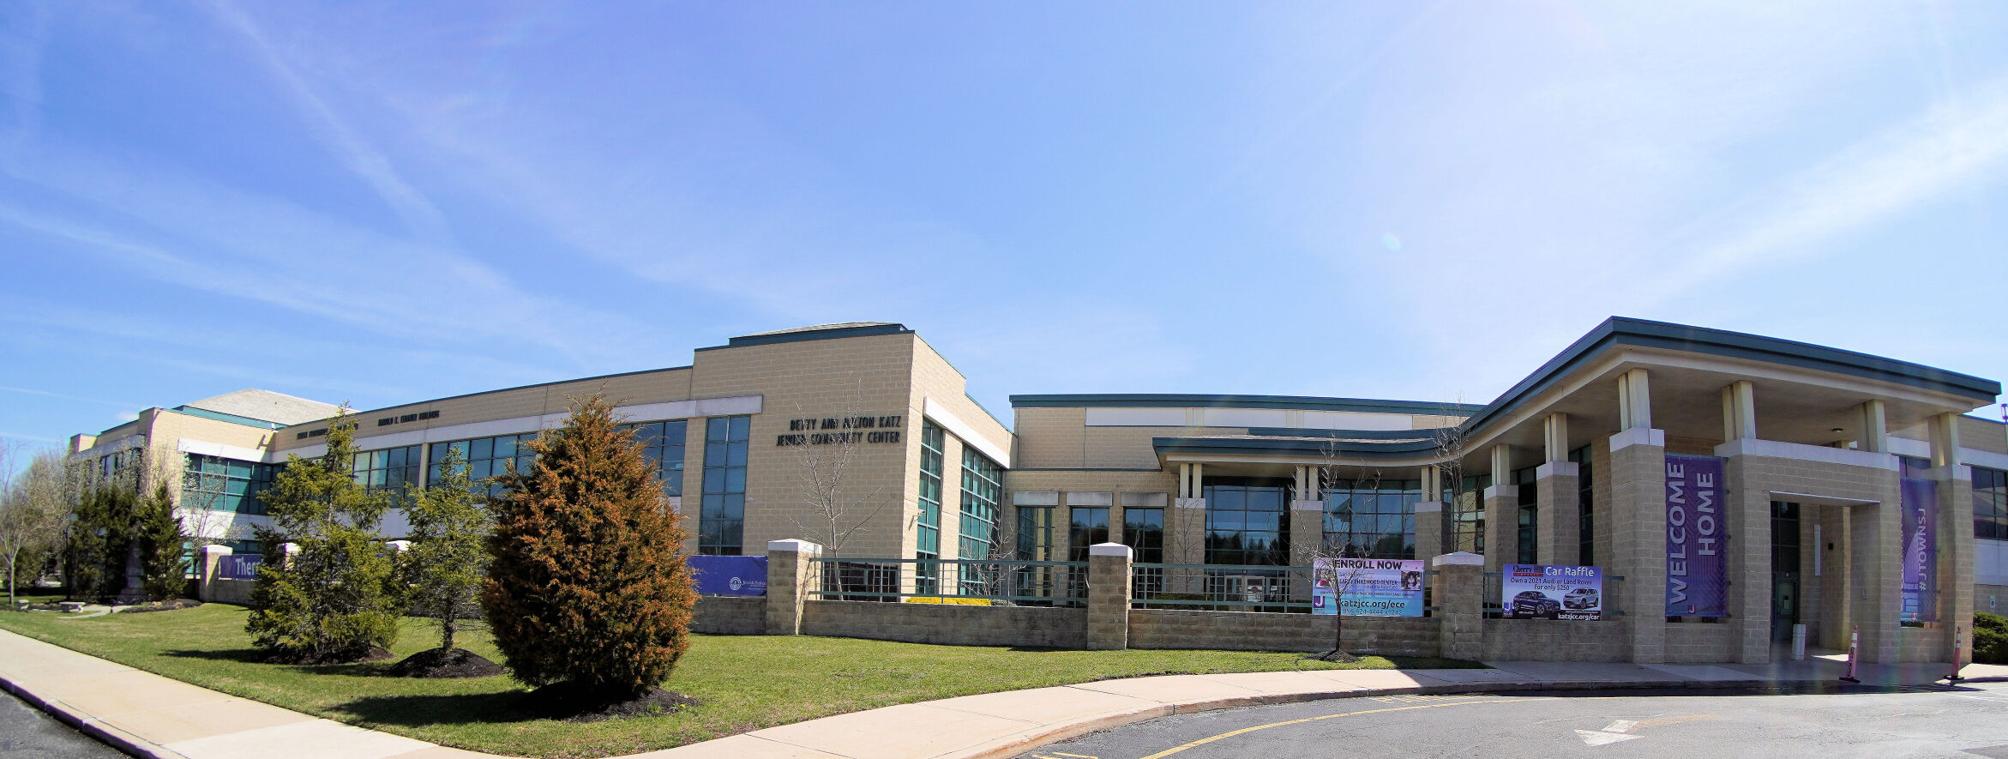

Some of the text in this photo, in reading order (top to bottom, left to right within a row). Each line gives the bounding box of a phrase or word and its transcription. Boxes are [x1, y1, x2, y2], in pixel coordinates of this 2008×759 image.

[790, 418, 817, 431] BETTY
[821, 418, 839, 430] AND
[879, 415, 902, 428] KATZ
[867, 431, 900, 444] CENTER
[1697, 472, 1716, 556] HOME
[1667, 463, 1687, 605] WELCOME
[1918, 508, 1927, 592] #JTOWNSJ
[1335, 559, 1402, 570] ENROLL NOW
[1546, 566, 1594, 577] Car Raffle
[1314, 595, 1324, 607] J
[1340, 599, 1405, 609] katzjcc.org/ece
[1558, 612, 1600, 620] katzjcc.org/car
